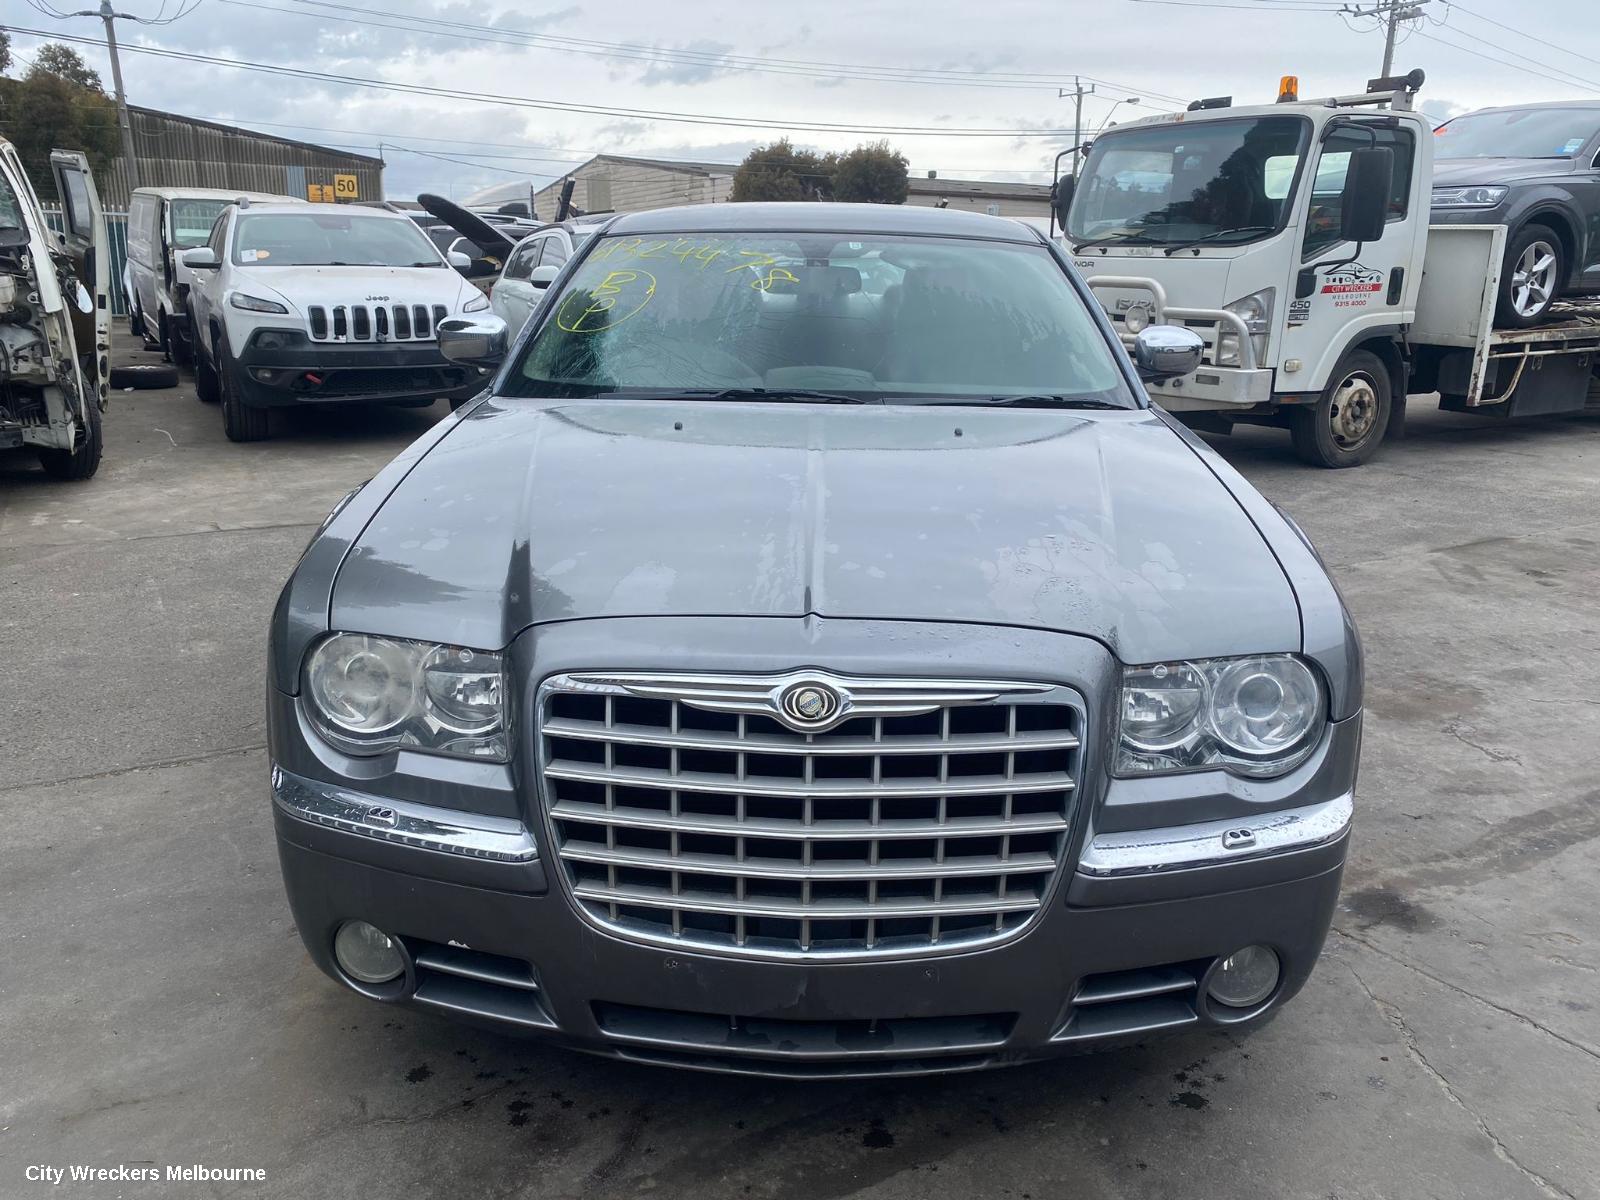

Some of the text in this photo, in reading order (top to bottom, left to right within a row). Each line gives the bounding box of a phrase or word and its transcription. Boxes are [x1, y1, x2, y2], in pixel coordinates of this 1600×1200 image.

[337, 179, 355, 192] 50
[1331, 283, 1373, 293] CITY WRECKERS
[1290, 300, 1311, 309] 450
